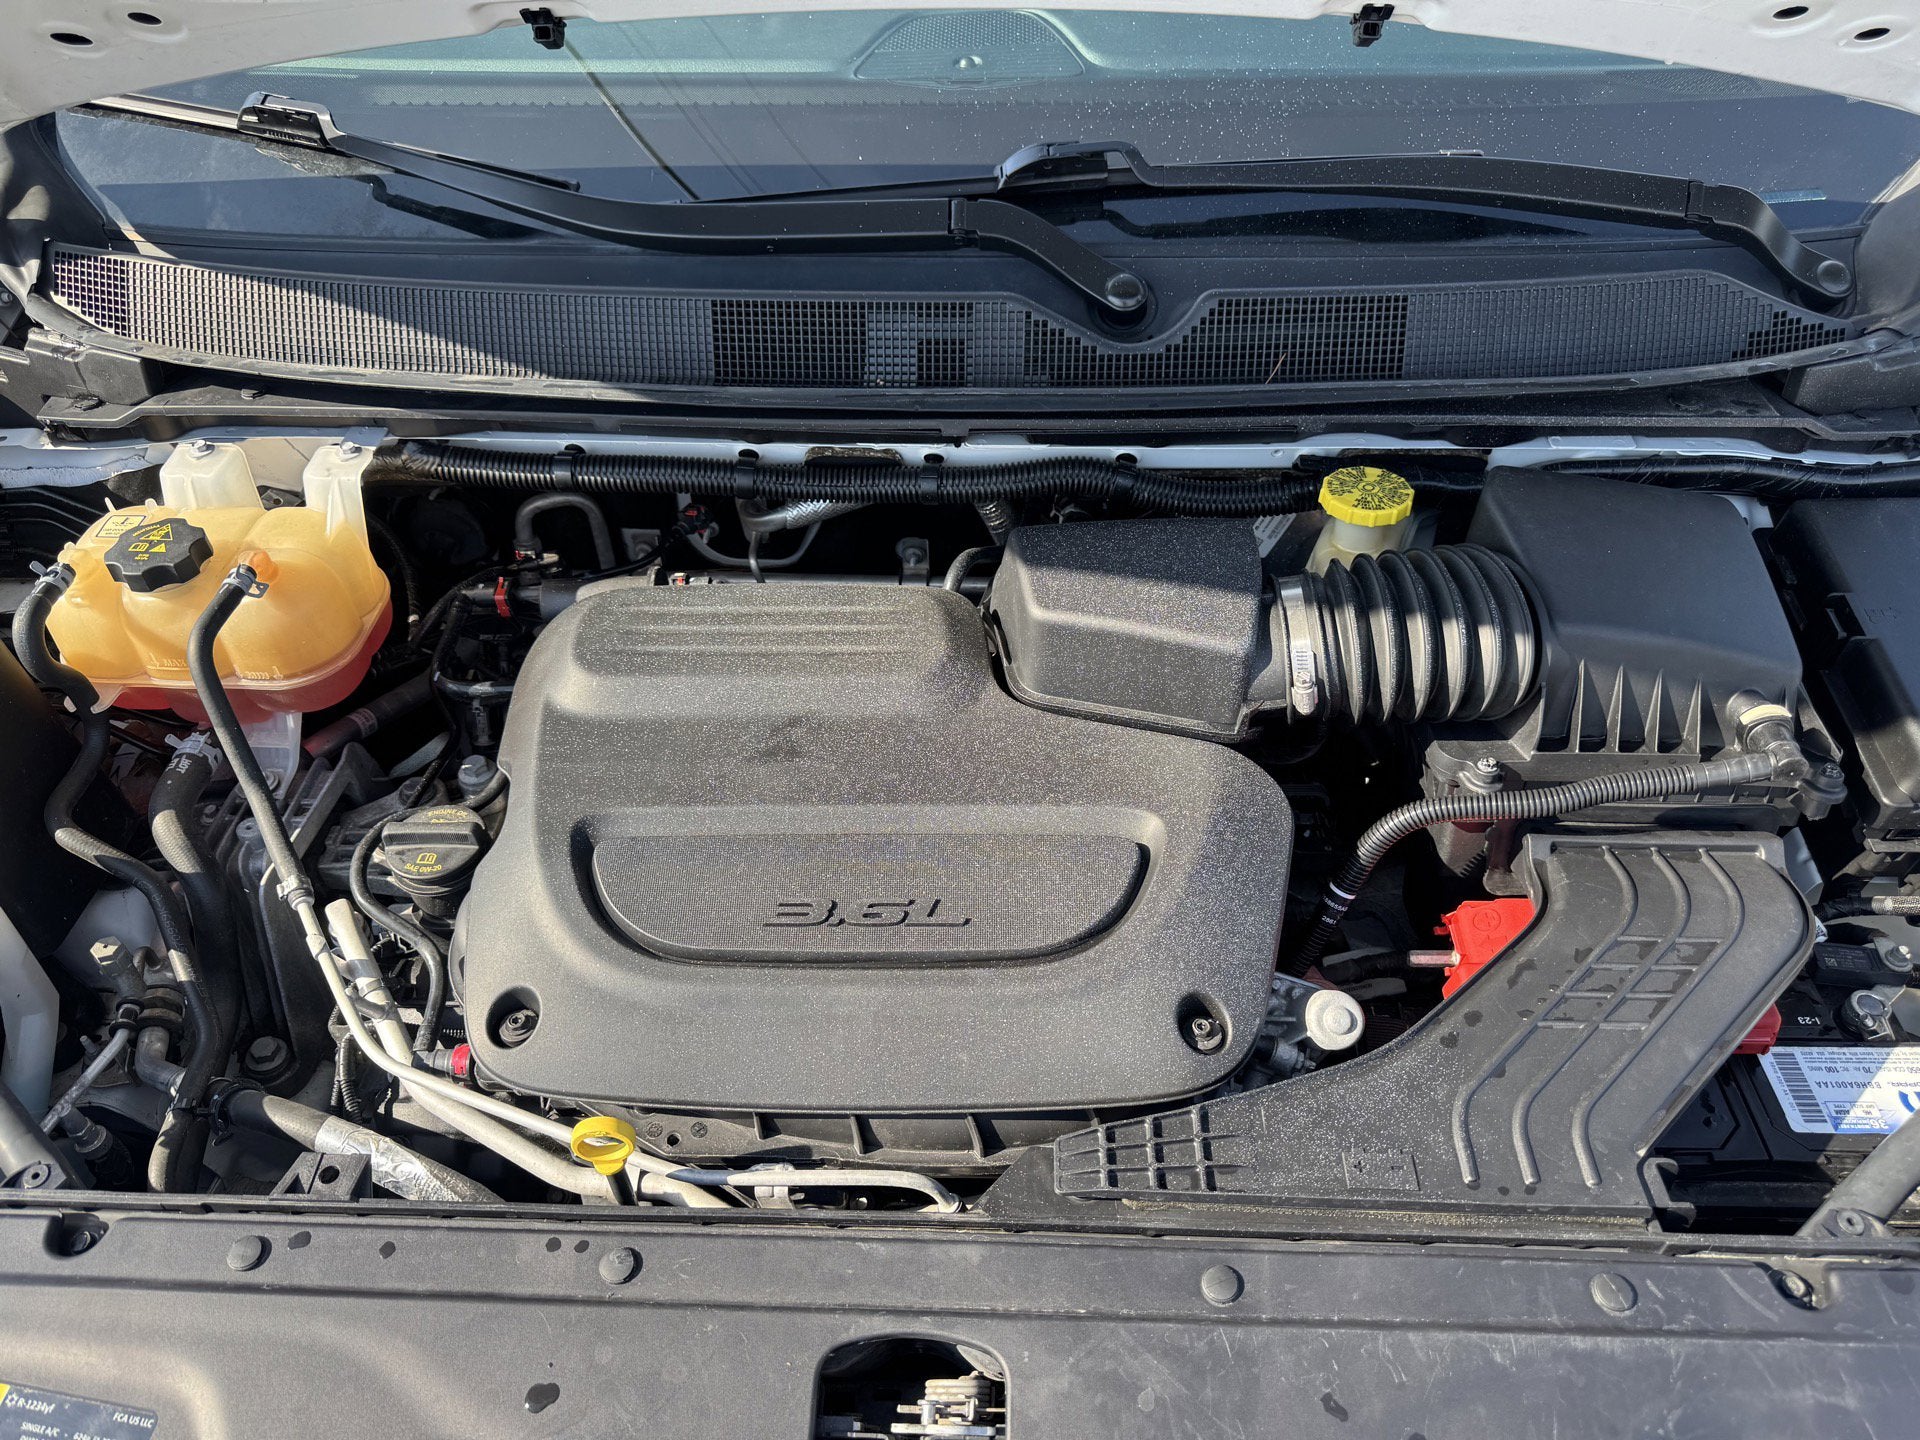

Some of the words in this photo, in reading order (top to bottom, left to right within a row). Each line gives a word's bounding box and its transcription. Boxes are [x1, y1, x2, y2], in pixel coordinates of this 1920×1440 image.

[405, 863, 419, 871] SAE
[763, 899, 972, 927] 3.6L
[1824, 1066, 1840, 1074] 100
[1863, 1066, 1873, 1074] 70
[1870, 1119, 1889, 1130] 36
[112, 1412, 129, 1423] FCA
[129, 1415, 140, 1426] US
[140, 1417, 155, 1429] LLC
[20, 1421, 46, 1434] SINGLE
